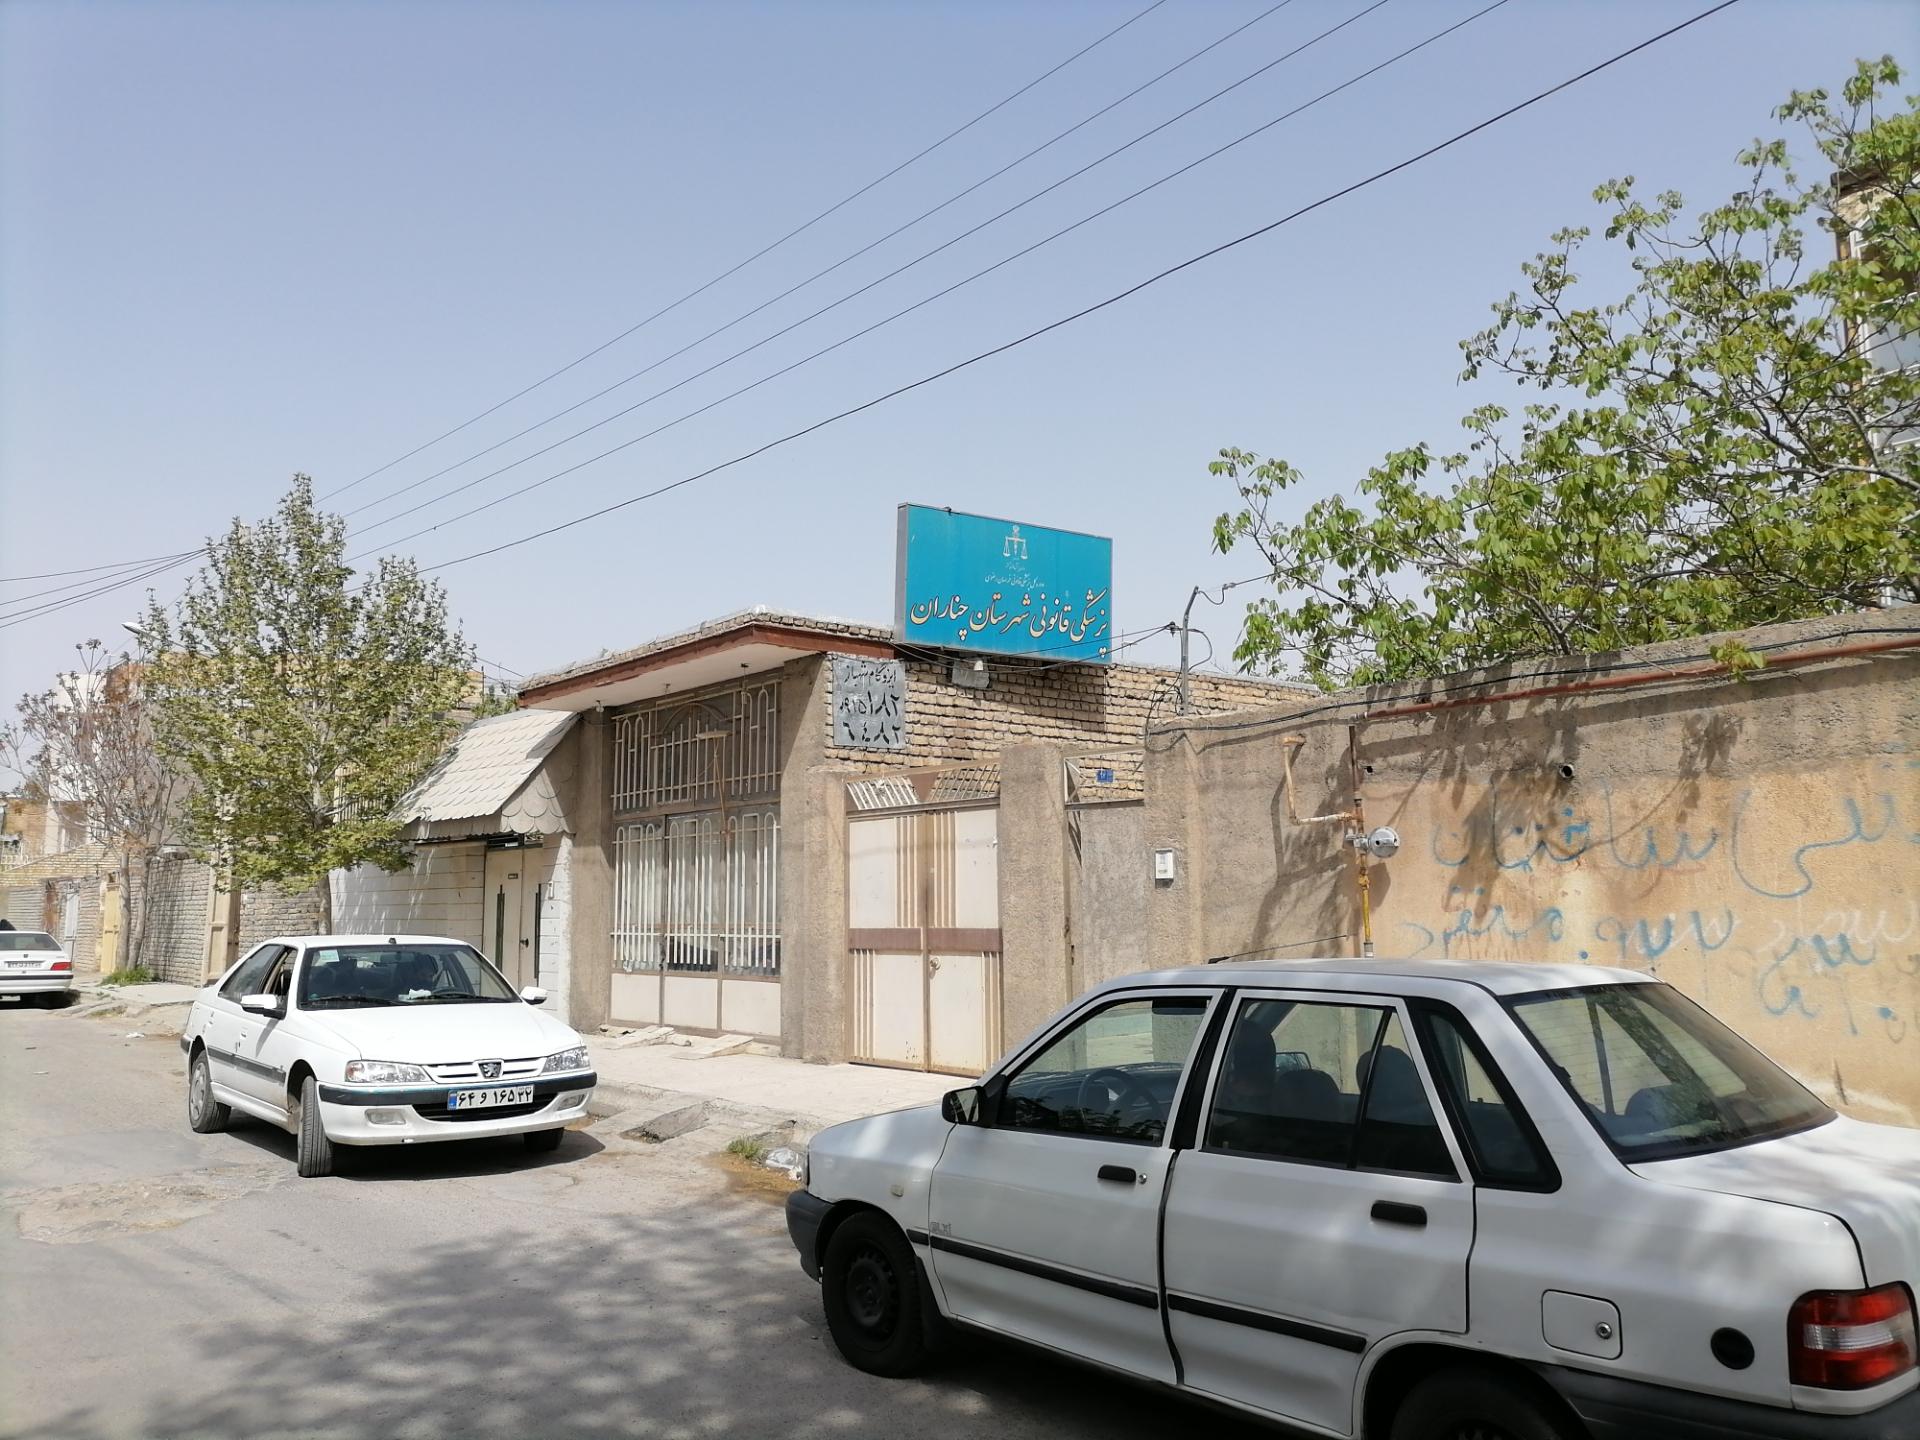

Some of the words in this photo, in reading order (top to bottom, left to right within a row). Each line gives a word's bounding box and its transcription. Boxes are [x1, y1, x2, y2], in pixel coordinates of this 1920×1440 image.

[910, 594, 969, 641] چناران
[969, 591, 1031, 635] شهرستان
[1029, 592, 1072, 638] قانونی
[1070, 587, 1108, 658] پزشکی
[868, 662, 897, 688] ایزوگام
